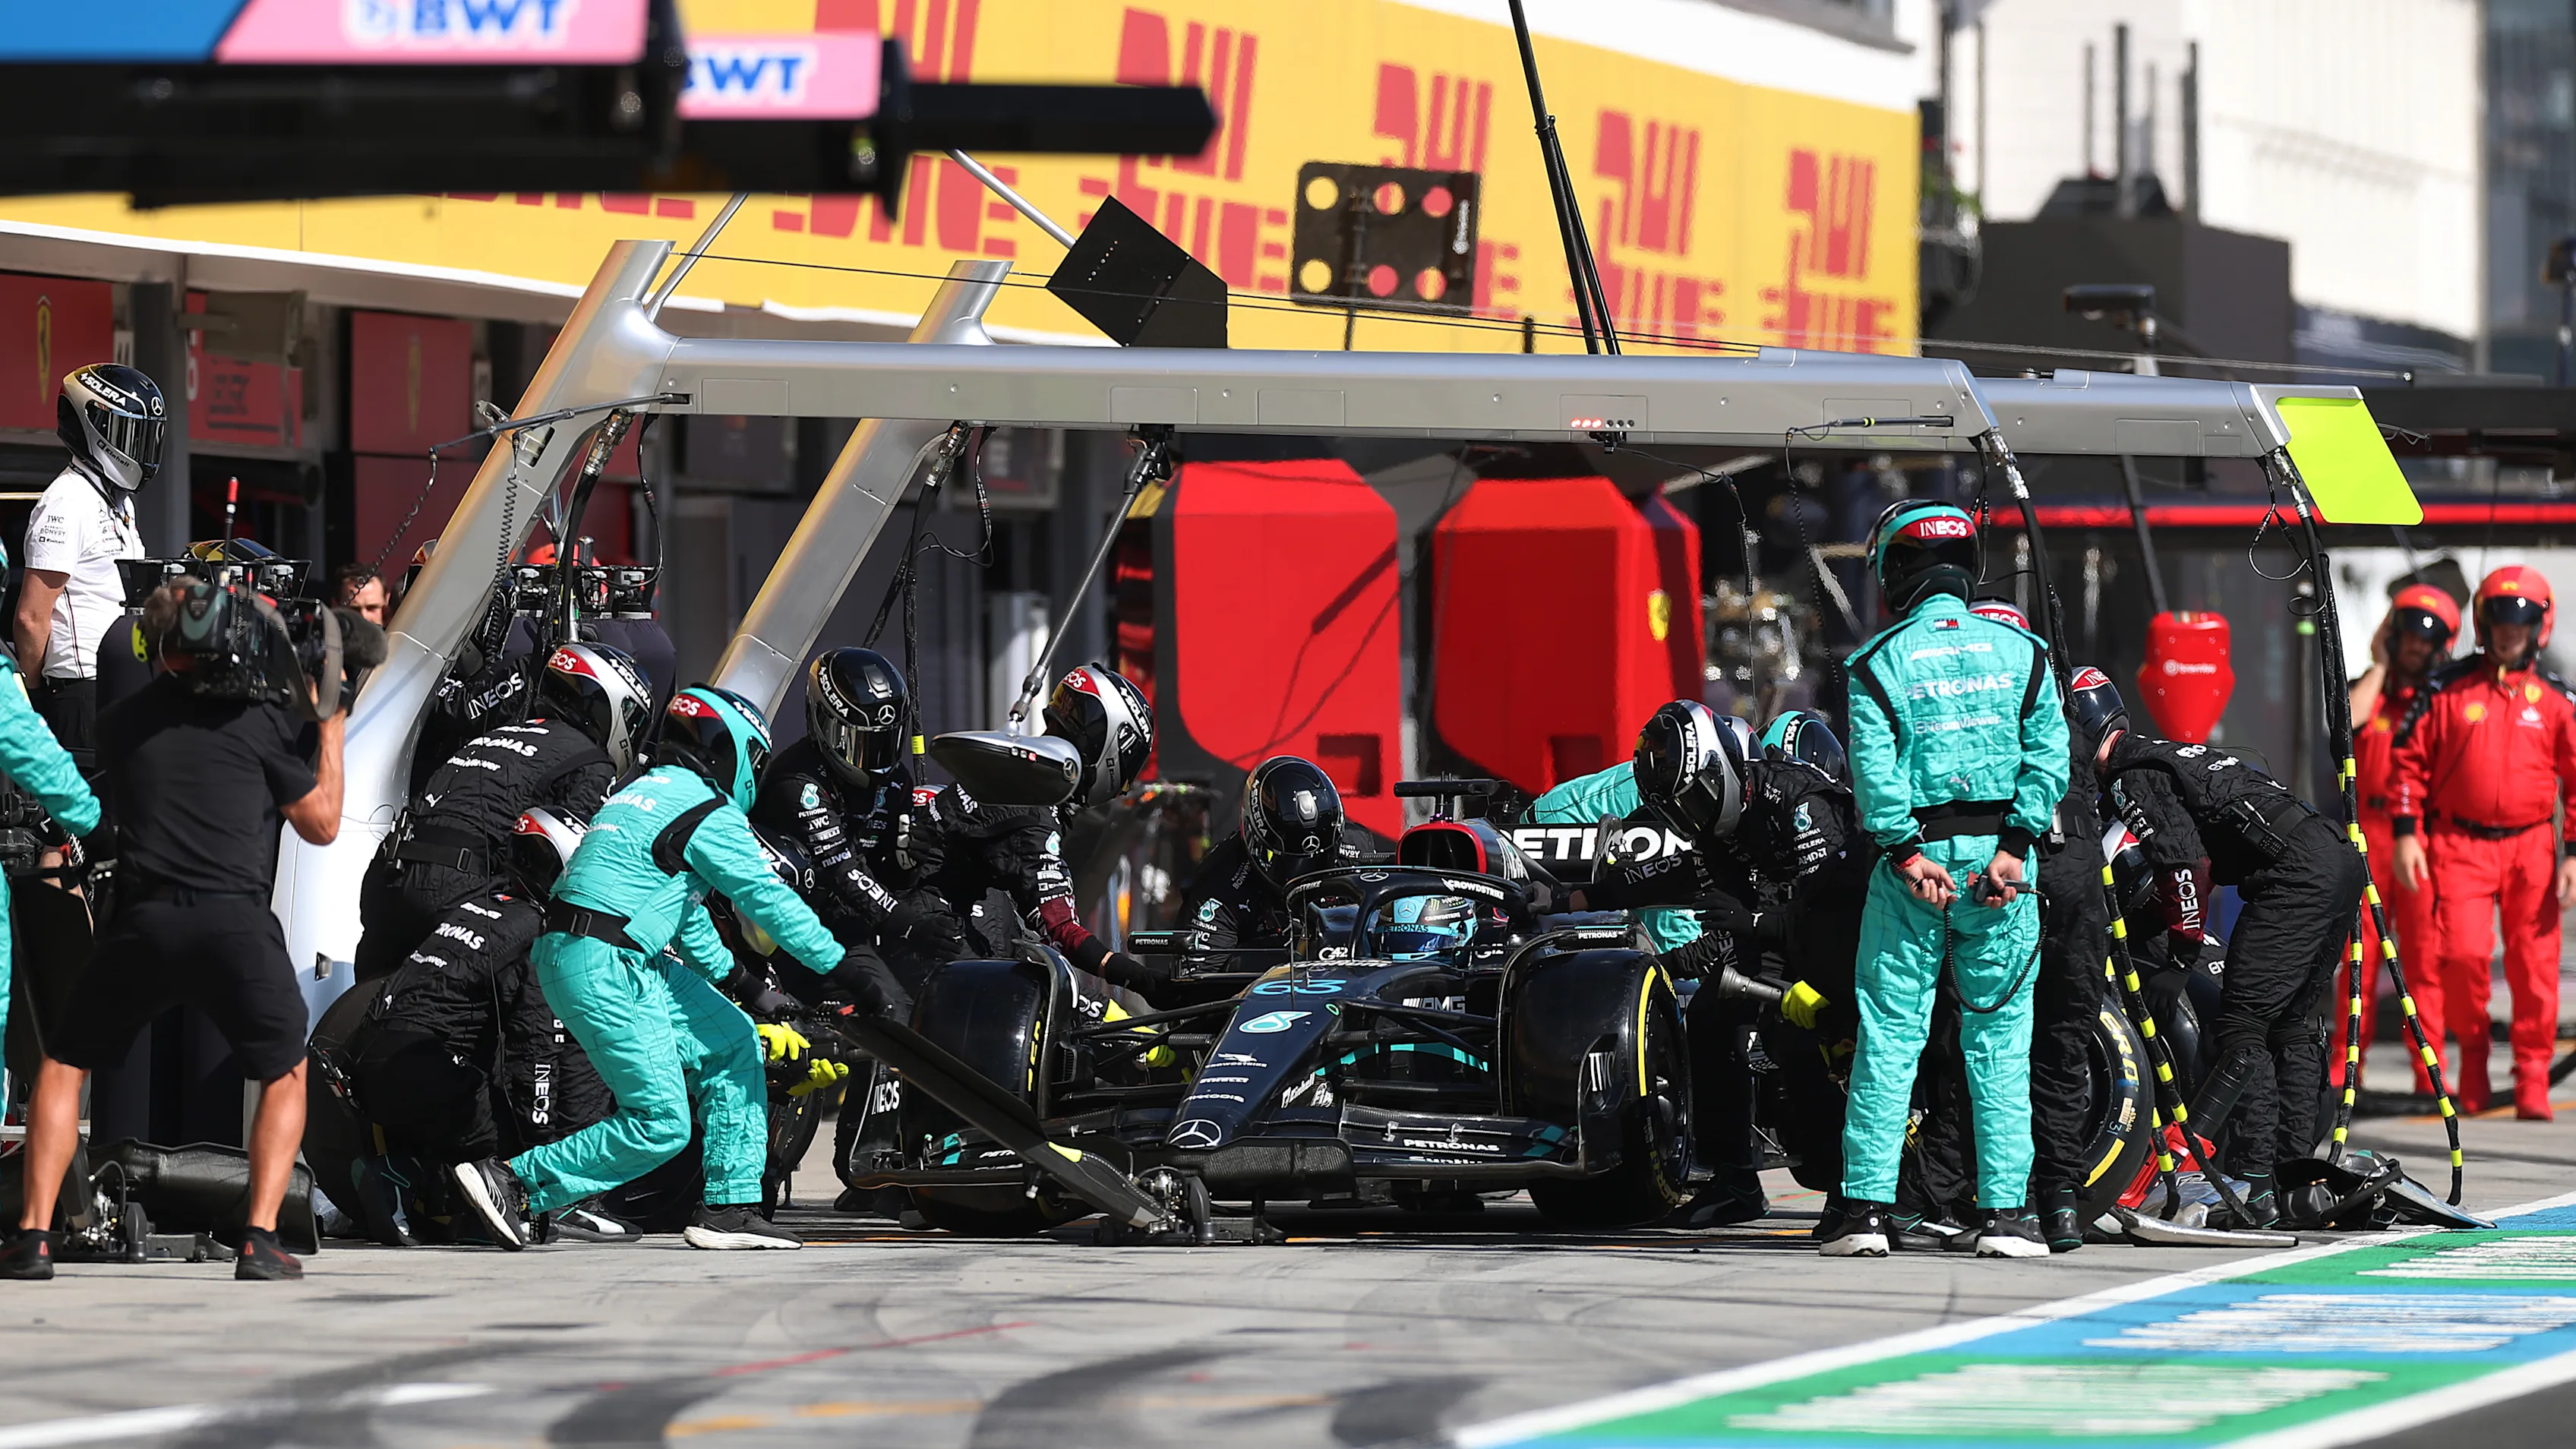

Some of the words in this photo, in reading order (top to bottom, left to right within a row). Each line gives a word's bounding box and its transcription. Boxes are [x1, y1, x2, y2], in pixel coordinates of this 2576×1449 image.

[412, 0, 559, 35] BWT
[684, 56, 805, 93] WT
[84, 376, 126, 407] SOLERA
[1920, 521, 1968, 538] INEOS
[551, 652, 577, 671] EOS
[616, 664, 652, 709] SOLERA
[1065, 671, 1087, 688] EOS
[1907, 672, 2013, 700] PETRONAS
[468, 671, 526, 720] INEOS
[672, 697, 701, 716] EOS
[820, 674, 849, 718] SOLERA
[1124, 694, 1151, 743] SOLERA
[1684, 721, 1697, 775] SOLERA
[1783, 724, 1798, 757] SOLE
[808, 815, 830, 831] IWC
[1251, 790, 1268, 838] SOLERA
[822, 847, 853, 868] nuvei
[1339, 848, 1361, 858] NVOY
[1623, 853, 1683, 886] INEOS
[847, 868, 899, 914] INEOS
[1447, 879, 1505, 901] CROWDSTRIKE
[2174, 868, 2201, 931] INEOS
[1384, 923, 1428, 933] PETRONAS
[1424, 911, 1461, 922] CROWDSTRIKE
[1252, 979, 1348, 996] 63
[1419, 995, 1466, 1014] AMG
[532, 1063, 551, 1125] INEOS
[871, 1080, 901, 1116] INEOS
[1289, 1071, 1316, 1103] Einhell
[1403, 1138, 1501, 1151] PETRONAS
